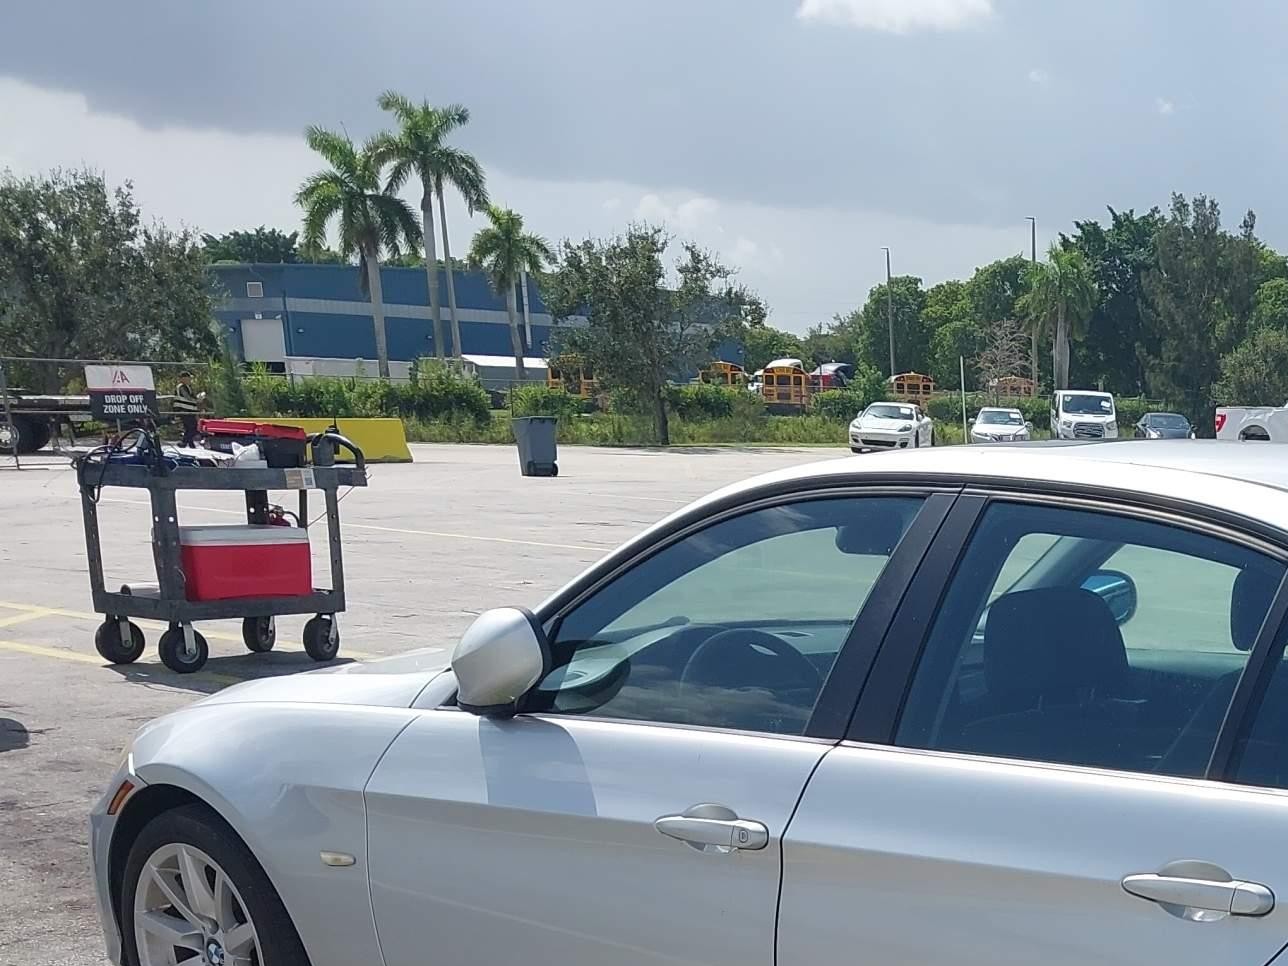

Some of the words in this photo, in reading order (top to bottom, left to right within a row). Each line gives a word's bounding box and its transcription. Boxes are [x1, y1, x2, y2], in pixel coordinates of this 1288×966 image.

[104, 394, 127, 404] DROP
[129, 394, 144, 404] OFF
[103, 404, 126, 414] ZONE
[127, 404, 148, 414] ONLY
